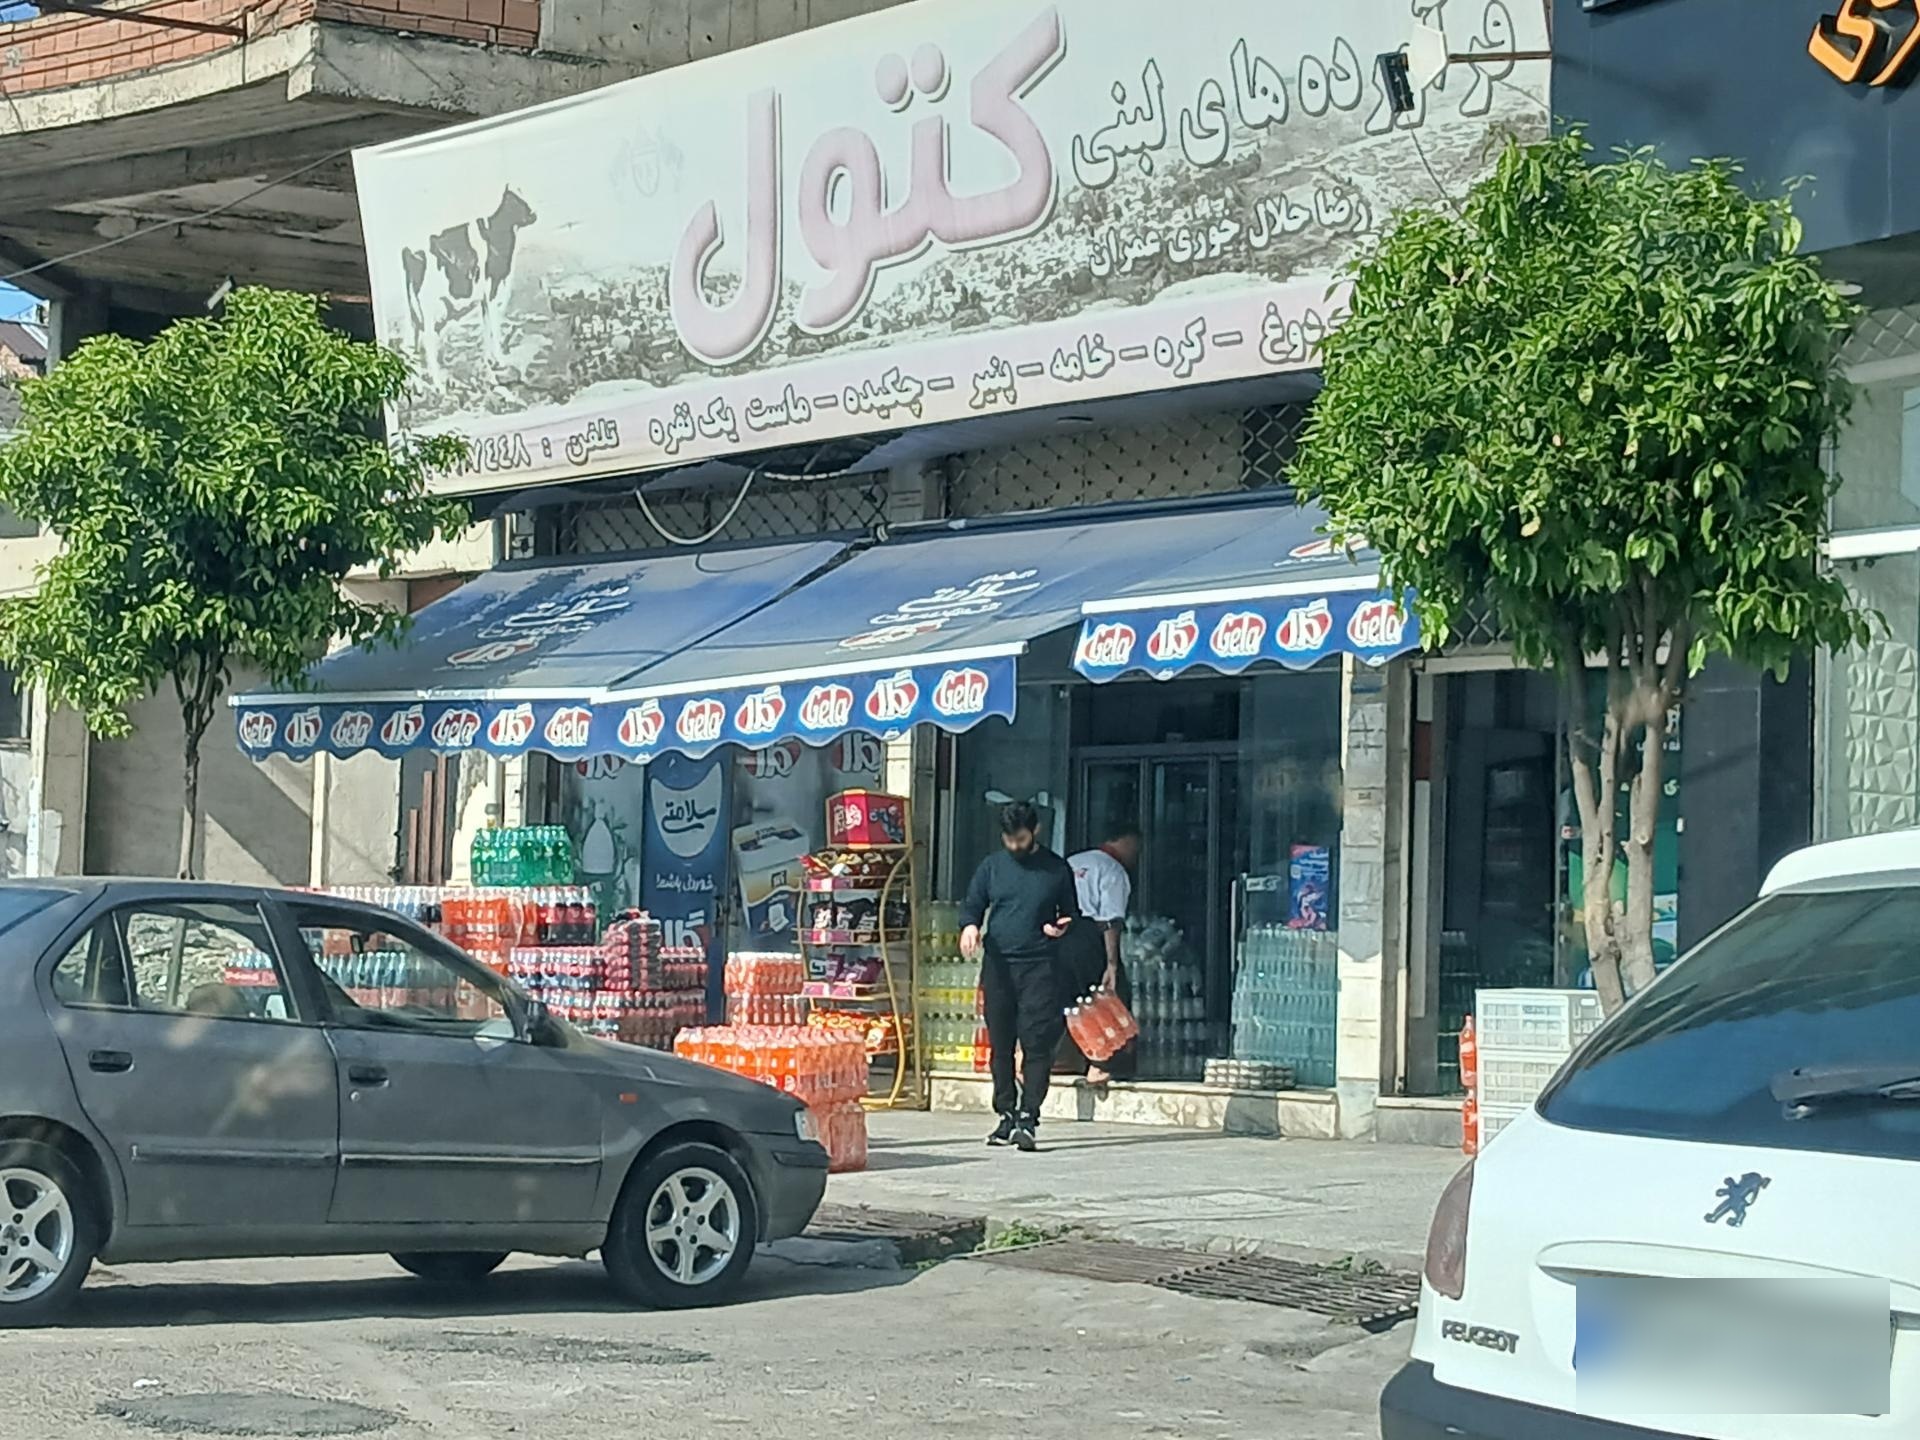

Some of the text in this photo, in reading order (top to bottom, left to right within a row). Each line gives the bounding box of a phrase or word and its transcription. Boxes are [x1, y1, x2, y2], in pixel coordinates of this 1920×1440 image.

[1072, 58, 1168, 189] لبنی
[1180, 38, 1289, 167] های
[669, 4, 1068, 368] کتول
[1249, 193, 1311, 250] حلال
[1312, 187, 1373, 233] رضا
[1088, 226, 1162, 277] عمران
[1154, 316, 1206, 378] کره
[1259, 302, 1327, 365] دوغ
[1049, 333, 1115, 382] خامه
[842, 366, 925, 419] چکیده
[969, 356, 1018, 409] پنیر
[697, 397, 740, 443] یک
[745, 384, 812, 432] ماست
[566, 418, 620, 467] تلفن
[1089, 623, 1132, 664] Gela
[1217, 612, 1263, 655] Gela
[1354, 600, 1403, 646] Gela
[805, 684, 850, 727] Gela
[938, 668, 986, 714] Gela
[435, 709, 476, 746] Gela
[549, 707, 591, 746] Gela
[680, 698, 723, 741] Gela
[660, 798, 718, 834] سلامتی
[1441, 1318, 1520, 1355] PEUGEOT
